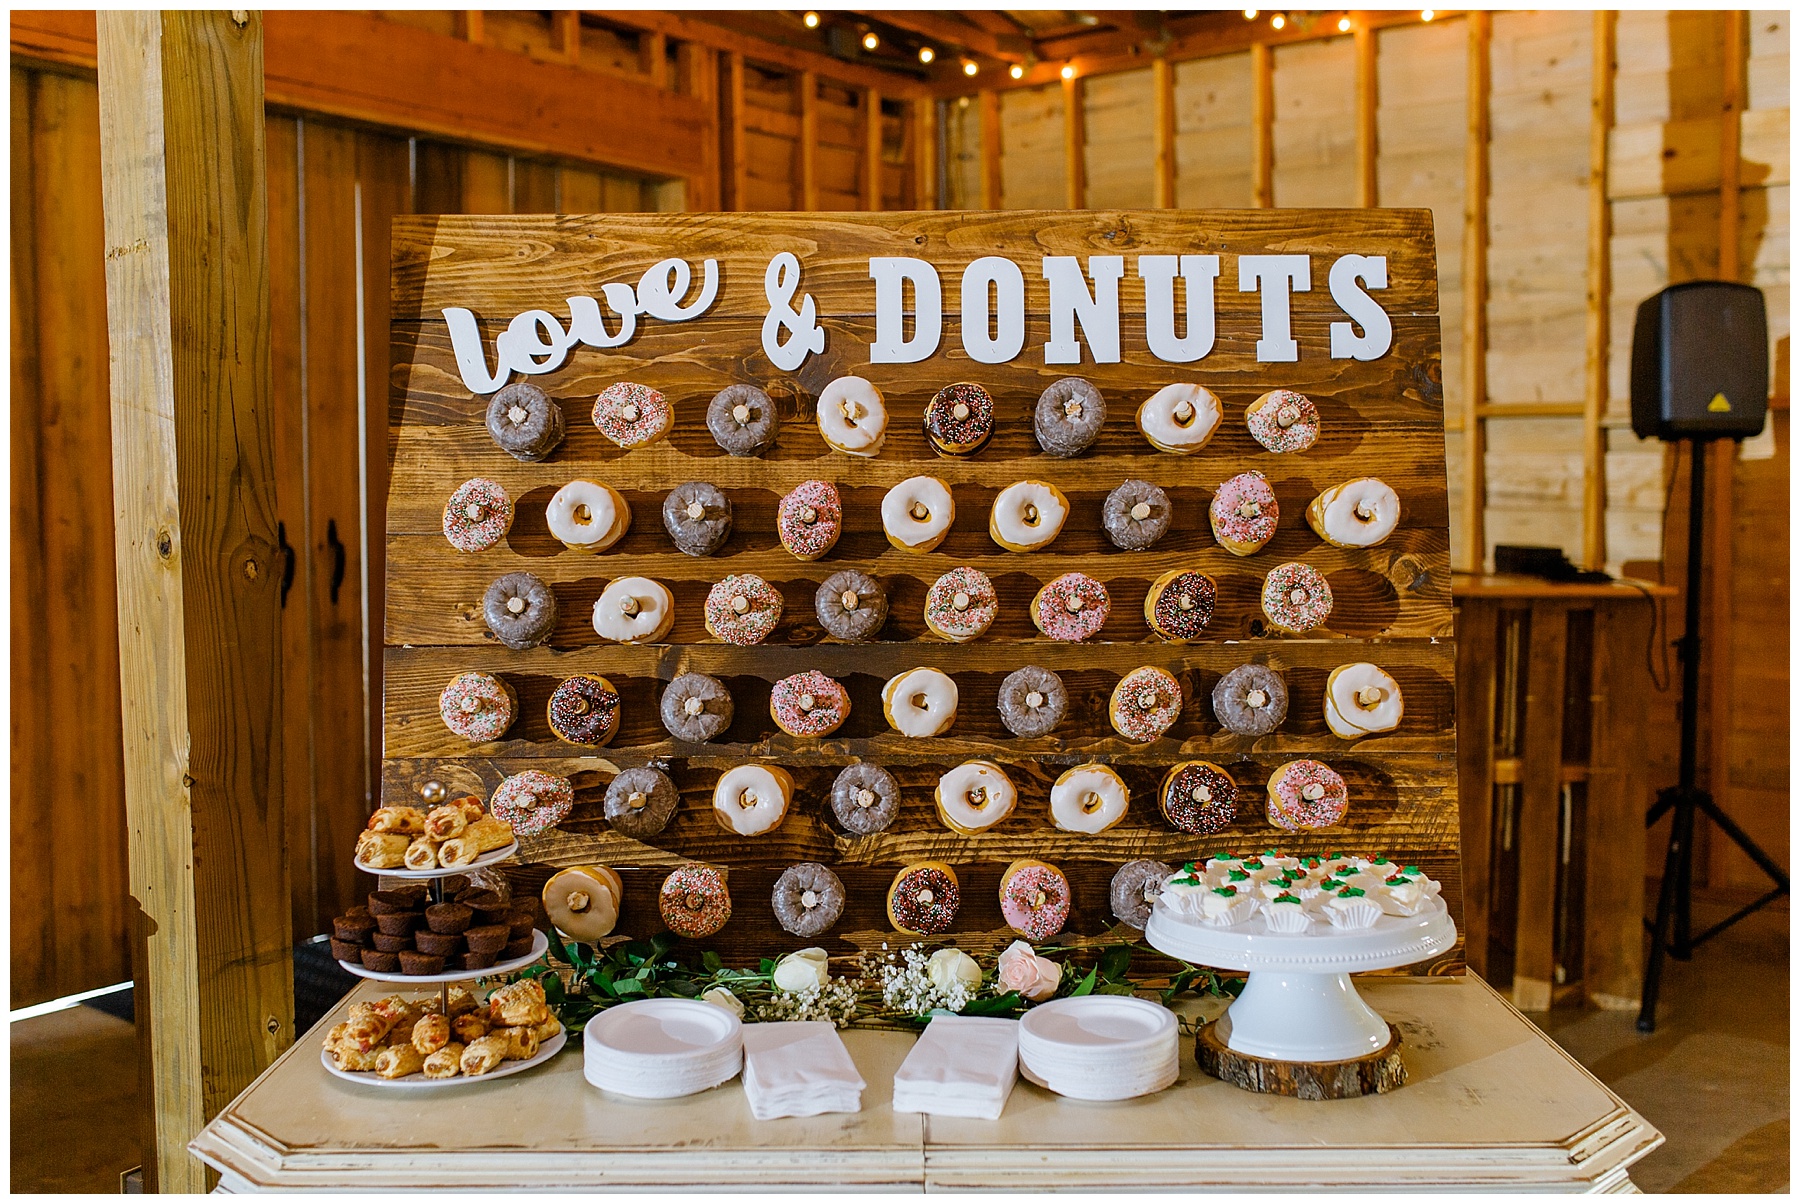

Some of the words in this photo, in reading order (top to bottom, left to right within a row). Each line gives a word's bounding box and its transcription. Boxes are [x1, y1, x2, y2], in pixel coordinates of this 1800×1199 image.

[441, 257, 719, 394] love
[761, 251, 825, 371] &
[869, 254, 1393, 364] DONUTS
